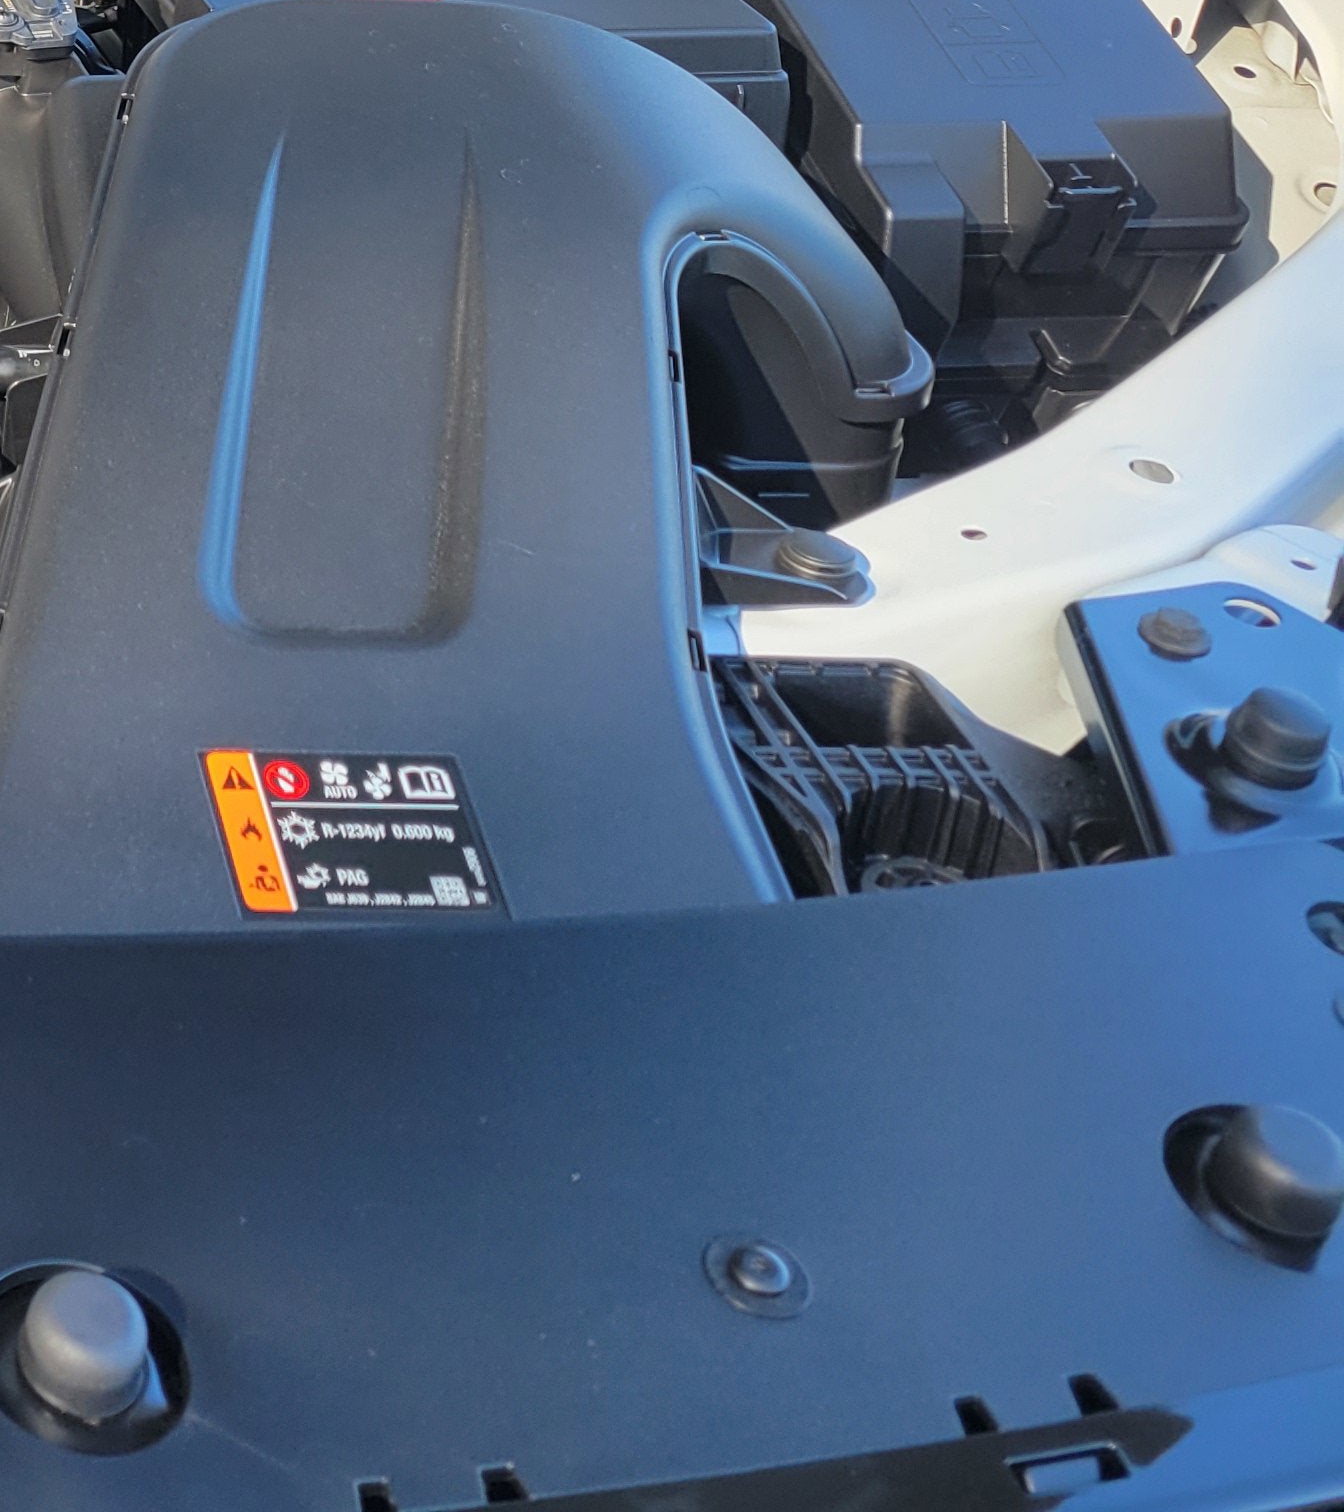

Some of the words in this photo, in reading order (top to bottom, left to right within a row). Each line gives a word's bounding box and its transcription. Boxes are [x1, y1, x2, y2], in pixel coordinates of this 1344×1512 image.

[324, 785, 358, 799] AUTO
[320, 822, 387, 842] R-1234yf
[433, 824, 455, 843] kg
[335, 868, 370, 886] PAG
